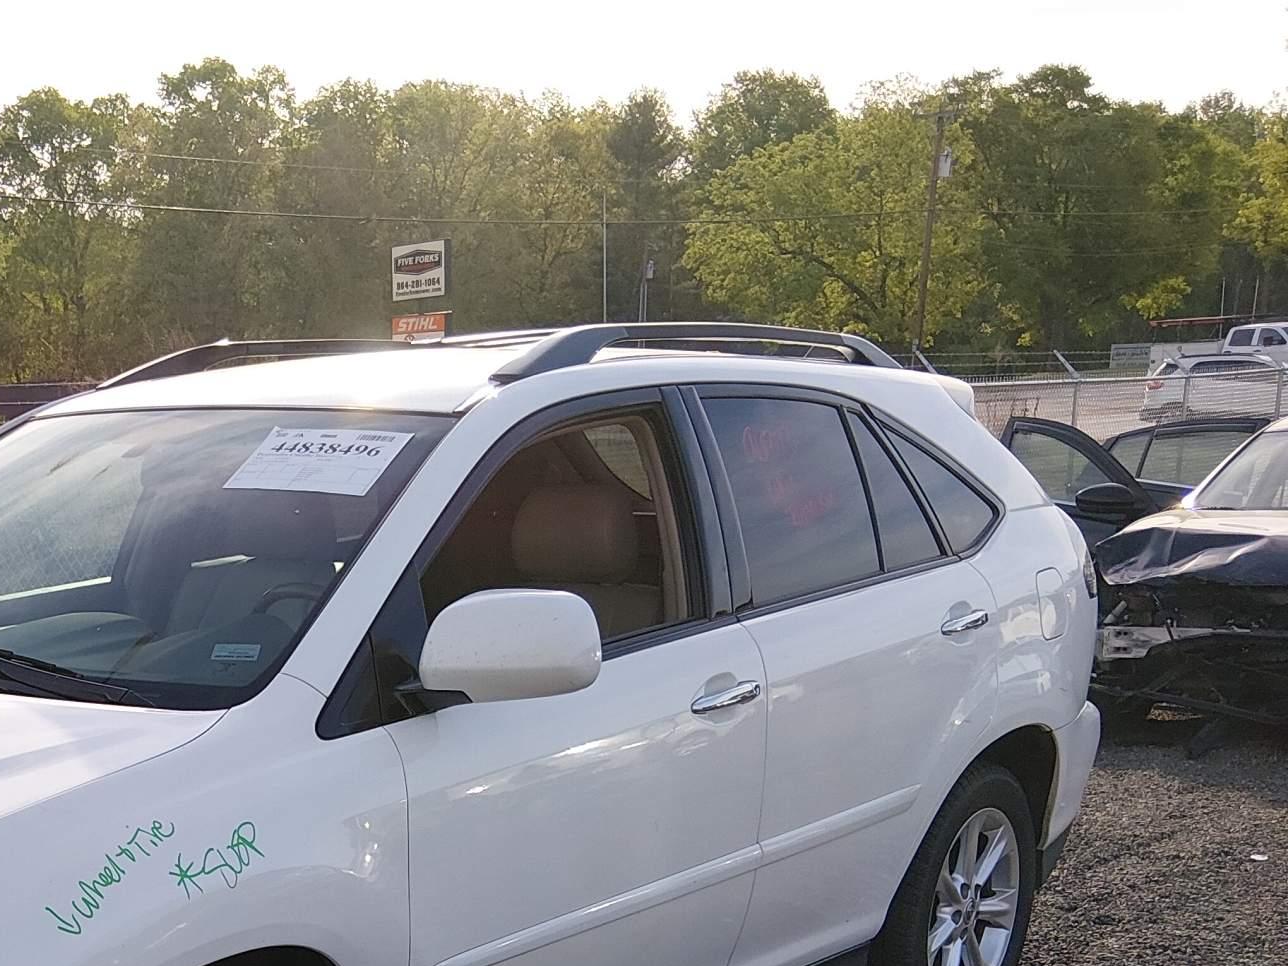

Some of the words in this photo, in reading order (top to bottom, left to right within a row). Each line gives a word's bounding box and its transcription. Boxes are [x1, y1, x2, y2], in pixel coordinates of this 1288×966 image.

[397, 256, 414, 267] FIVE
[414, 253, 440, 265] FORKS
[398, 316, 438, 332] STIHL
[271, 440, 382, 458] 44838496
